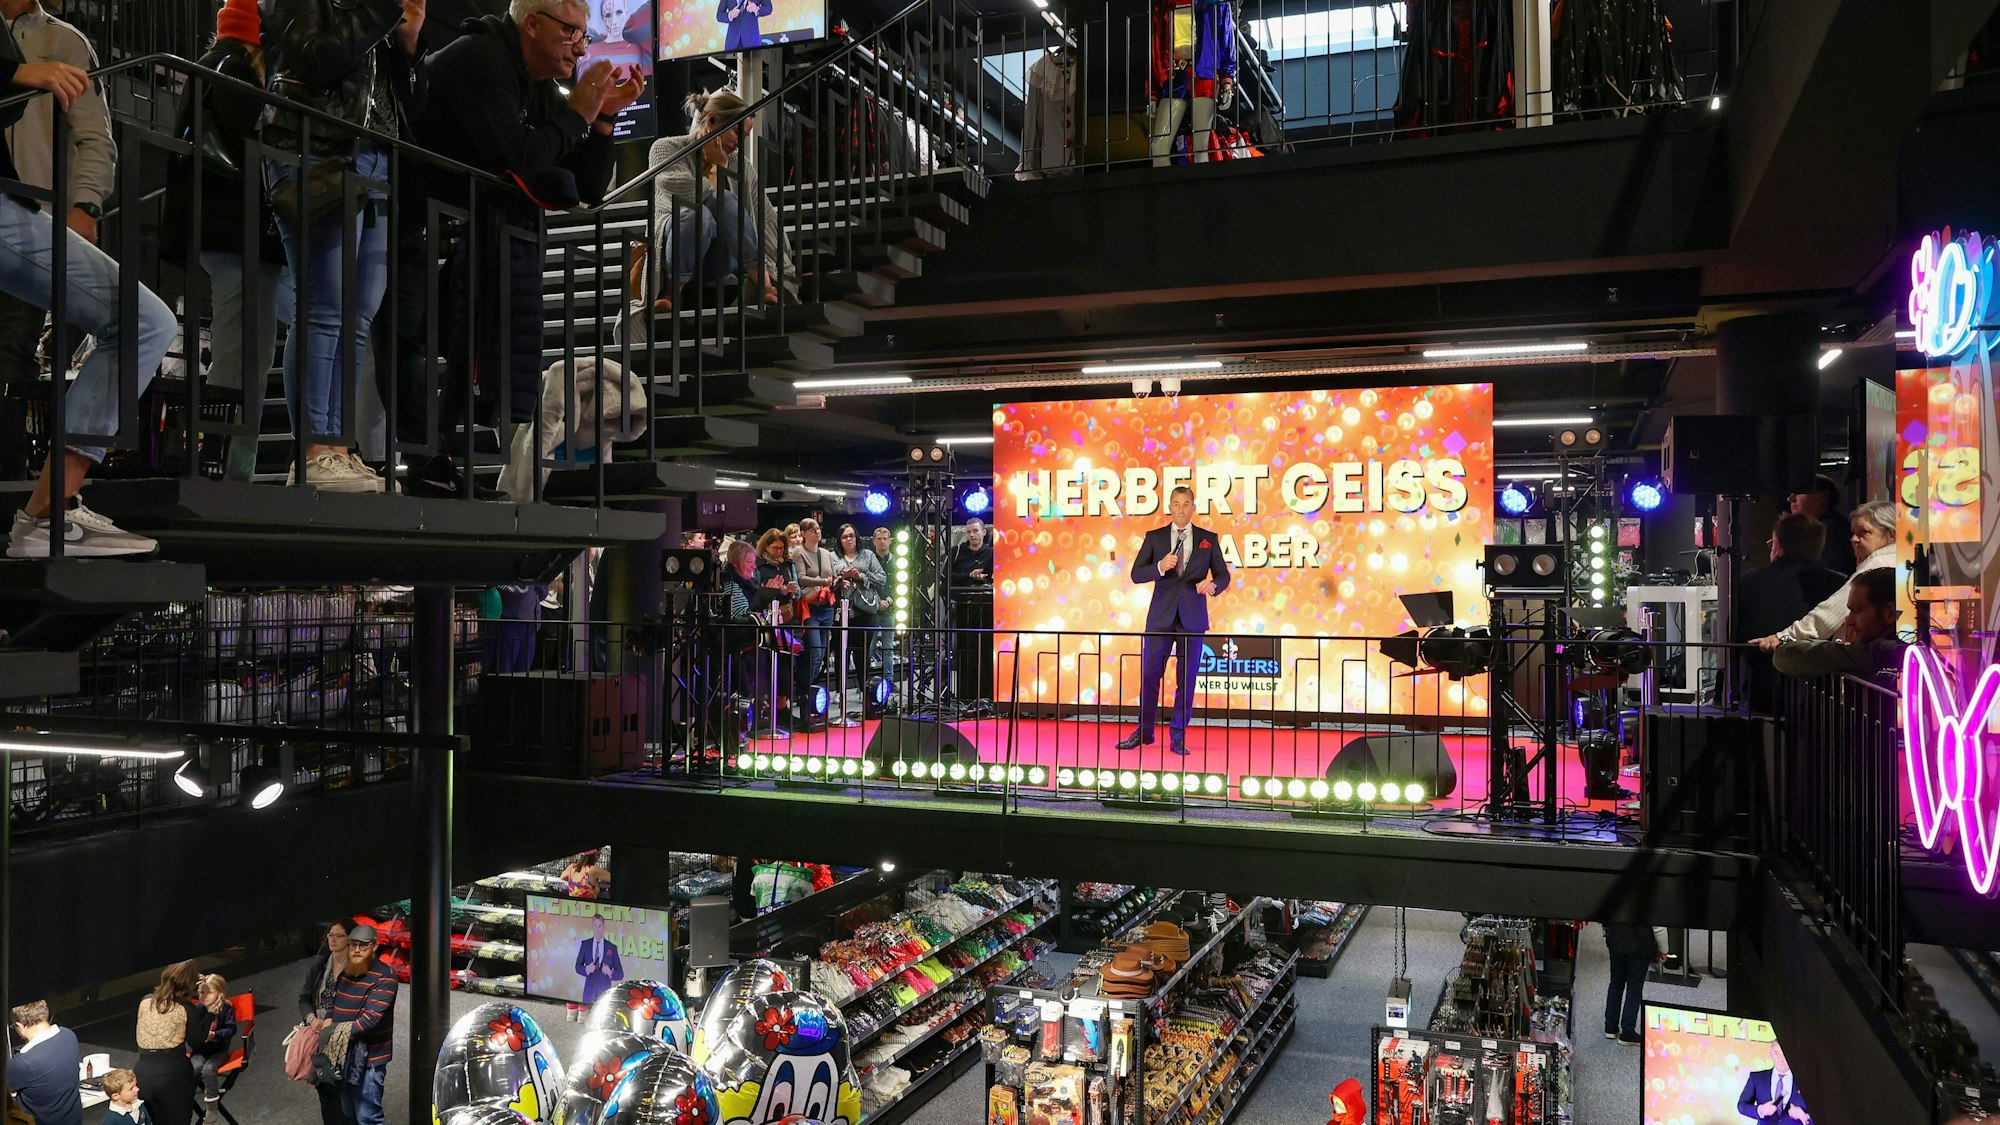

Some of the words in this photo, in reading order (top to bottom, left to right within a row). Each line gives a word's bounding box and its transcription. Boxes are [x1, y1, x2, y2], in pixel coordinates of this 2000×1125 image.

[1015, 464, 1268, 517] HERBERT
[1281, 458, 1467, 514] GEISS
[1198, 643, 1279, 674] DEITERS
[1199, 681, 1220, 690] WER
[1224, 681, 1238, 690] DU
[1241, 682, 1278, 691] WILLST
